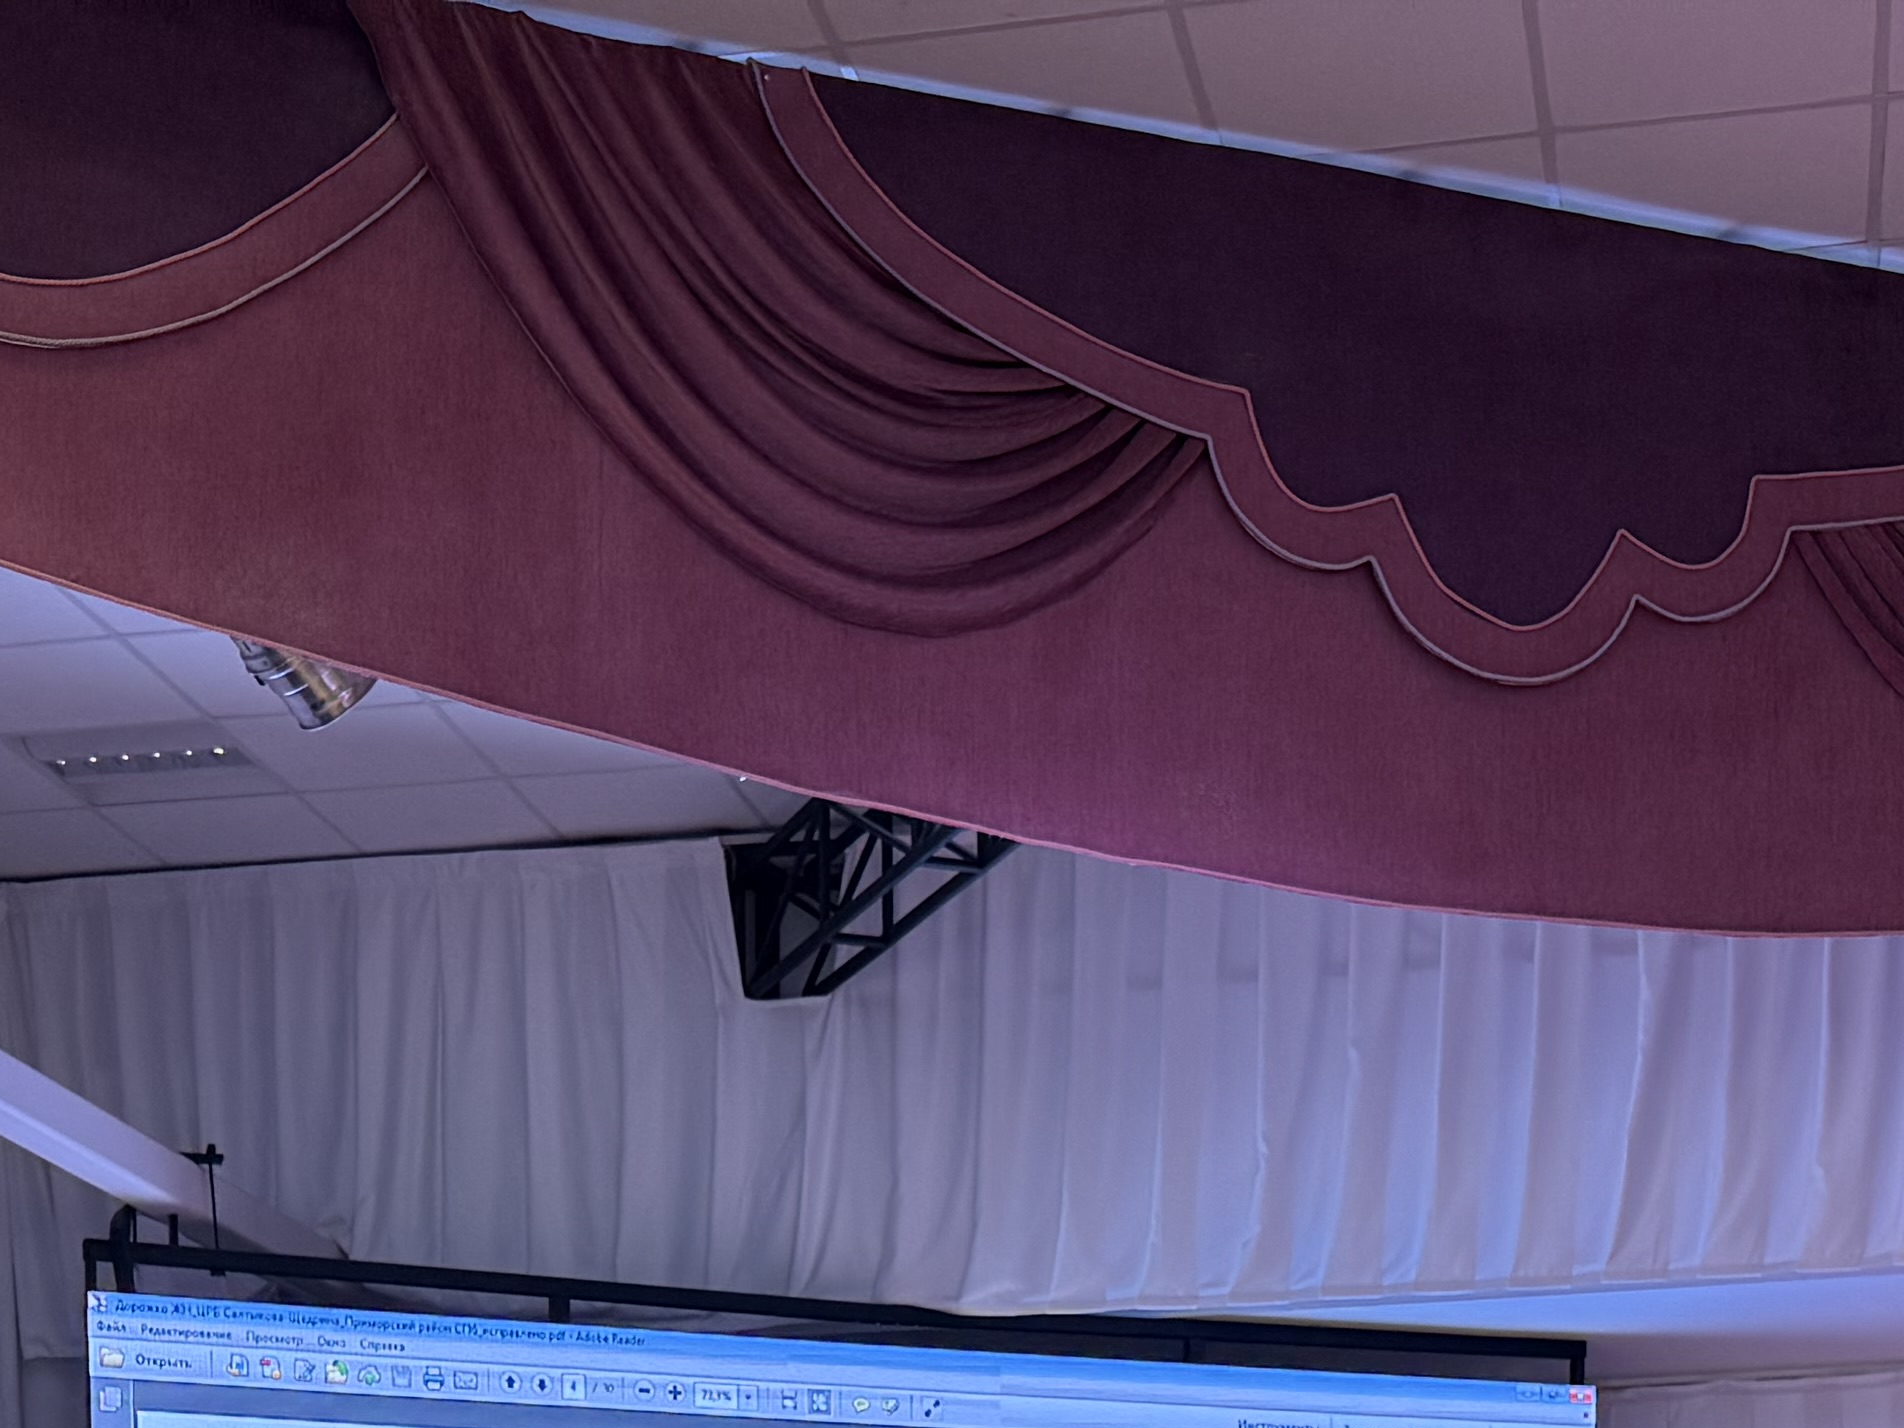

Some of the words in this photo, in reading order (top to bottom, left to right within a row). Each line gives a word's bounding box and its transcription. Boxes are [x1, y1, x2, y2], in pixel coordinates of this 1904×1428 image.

[97, 1320, 127, 1333] Файл
[141, 1323, 232, 1341] Редактирование
[247, 1330, 303, 1346] Просмотр
[135, 1354, 192, 1369] Открыть
